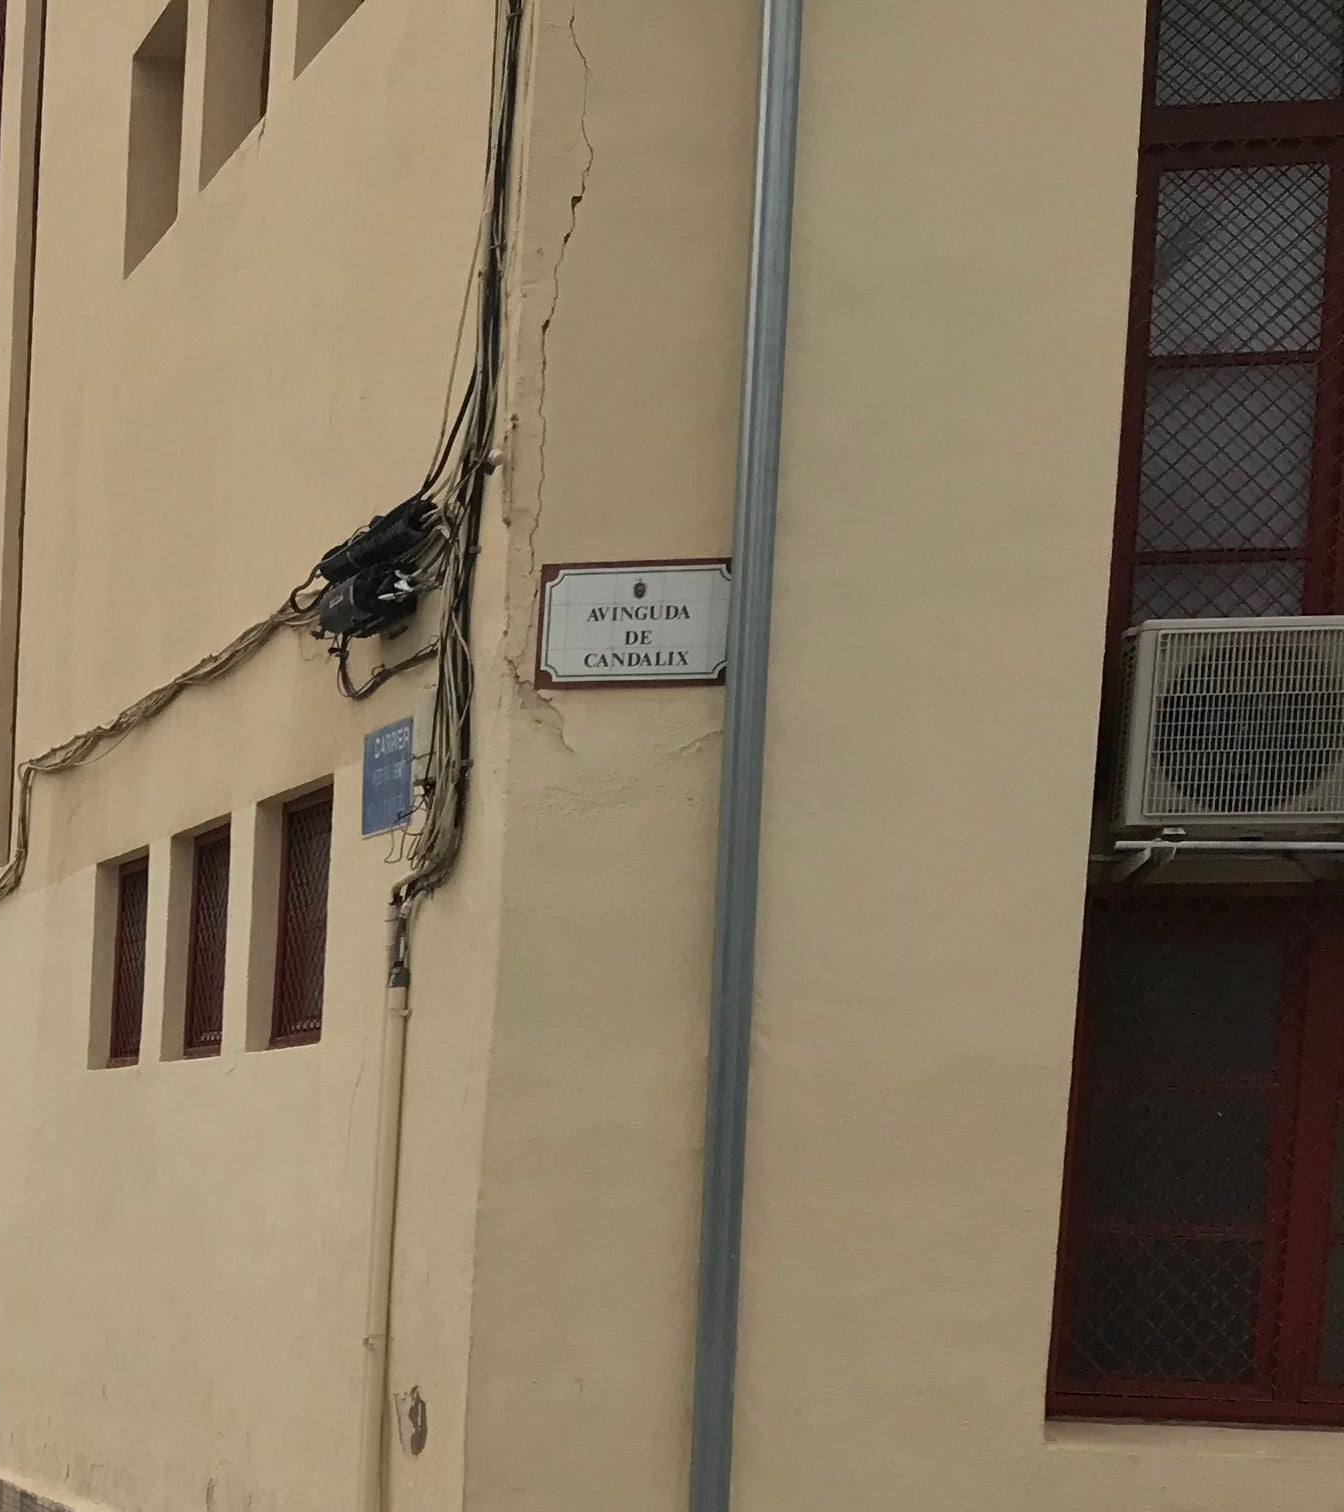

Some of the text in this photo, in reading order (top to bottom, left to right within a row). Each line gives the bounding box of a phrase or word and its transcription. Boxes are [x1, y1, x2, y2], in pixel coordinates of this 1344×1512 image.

[586, 604, 691, 623] AVINGUDA
[624, 629, 653, 646] DE
[583, 650, 690, 669] CANDALIX
